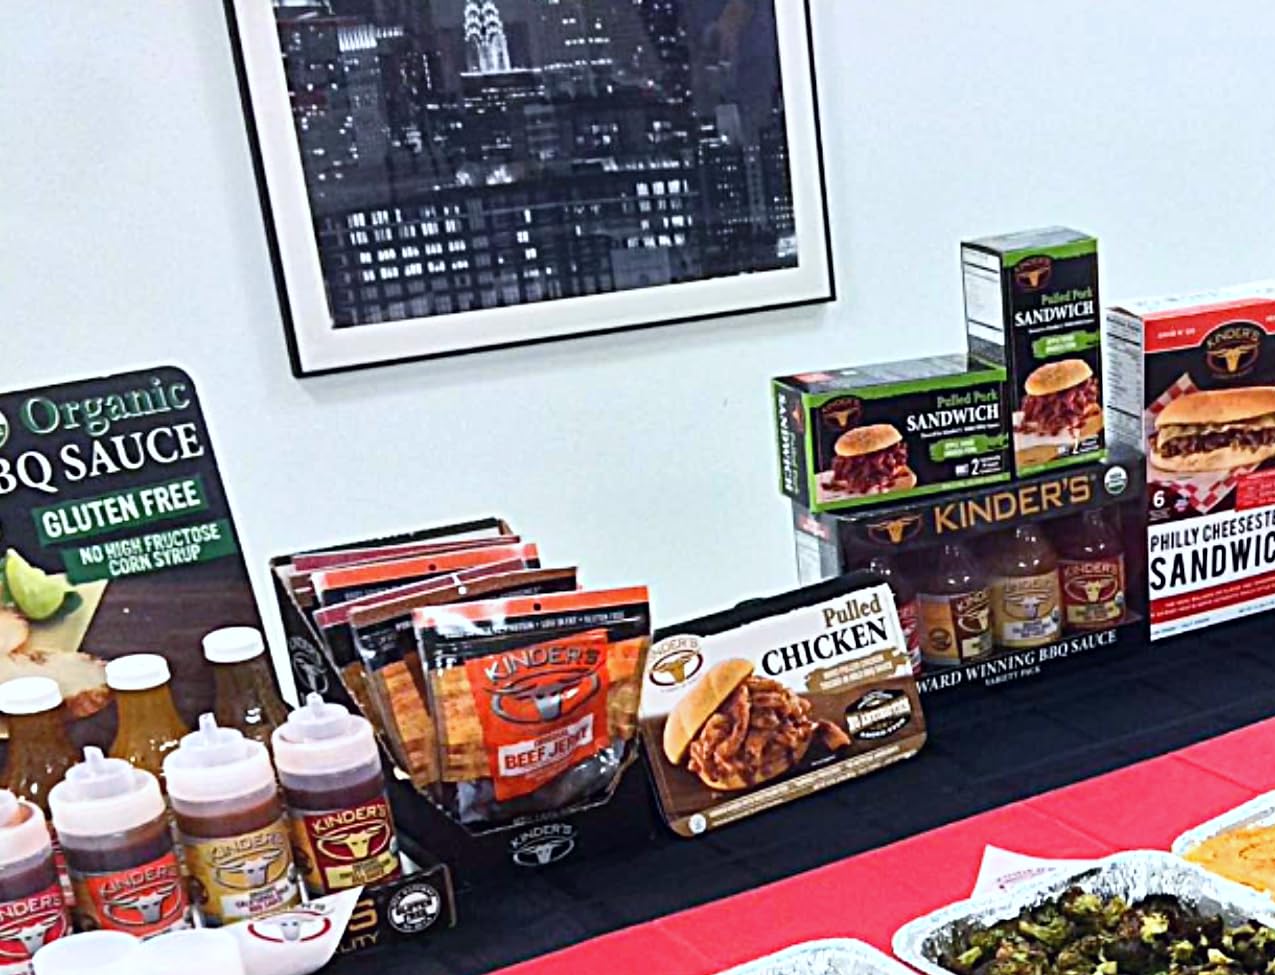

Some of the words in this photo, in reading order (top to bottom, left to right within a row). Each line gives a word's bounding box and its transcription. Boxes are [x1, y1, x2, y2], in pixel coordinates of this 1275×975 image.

[1014, 300, 1094, 327] SANDWICH
[20, 377, 191, 437] Organic
[906, 403, 999, 432] SANDWICH
[60, 422, 204, 481] SAUCE
[970, 457, 979, 475] 2
[42, 493, 139, 538] GLUTEN
[141, 480, 200, 515] FREE
[934, 476, 1093, 535] KINDER'S
[1153, 490, 1165, 508] 6
[79, 545, 104, 565] NO
[104, 540, 143, 560] HIGH
[144, 524, 221, 551] FRUCTOSE
[1150, 527, 1199, 552] PHILLY
[109, 553, 152, 577] CORN
[153, 547, 200, 568] SYRUP
[822, 592, 882, 628] Pulled
[762, 617, 889, 676] CHICKEN
[965, 651, 1036, 681] WINNING
[1039, 642, 1069, 661] BBQ
[1071, 629, 1118, 653] SAUCE
[484, 644, 601, 682] KINDER'S
[504, 747, 546, 770] BEEF
[312, 804, 386, 833] KINDER'S
[510, 823, 573, 848] KINDER'S
[336, 931, 379, 953] LITY
